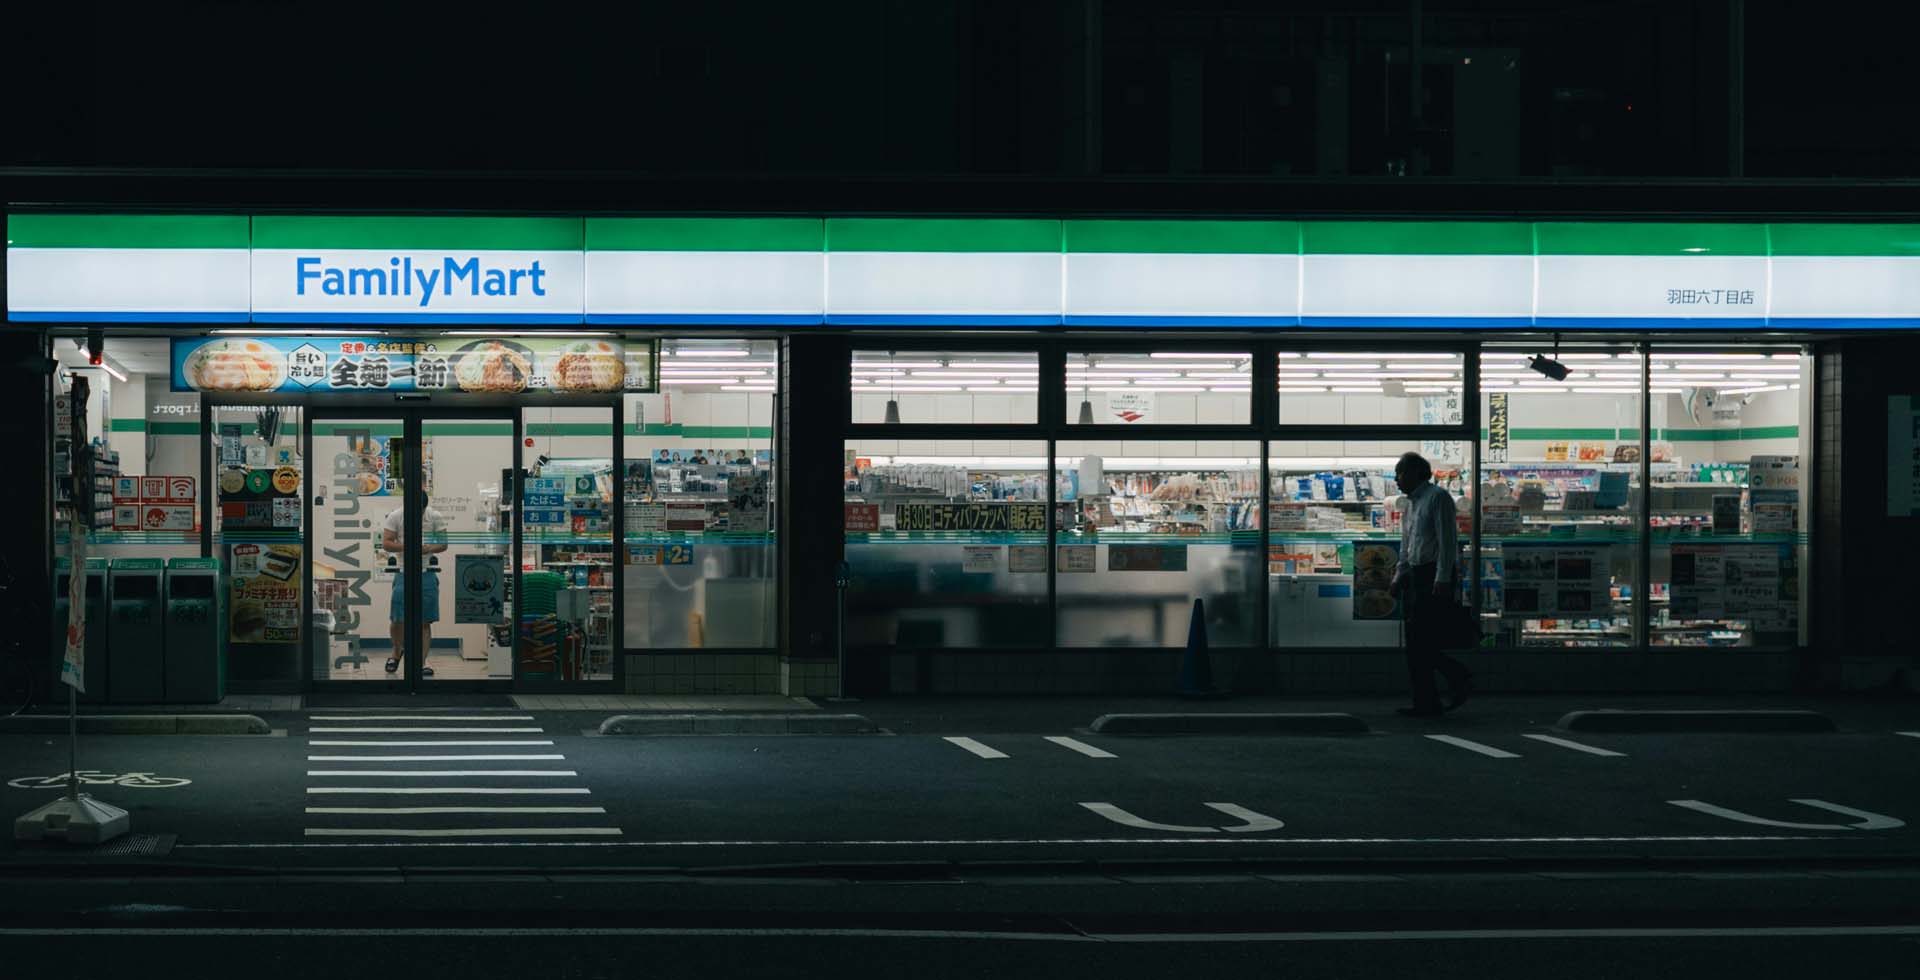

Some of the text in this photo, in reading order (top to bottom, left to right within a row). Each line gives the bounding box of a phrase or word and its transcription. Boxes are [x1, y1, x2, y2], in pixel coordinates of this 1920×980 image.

[296, 256, 546, 307] FamilyMart
[1667, 289, 1755, 305] 羽田六丁目店
[330, 358, 447, 387] 全麺一新
[529, 495, 558, 505] たばこ
[323, 428, 371, 670] FamilyMart
